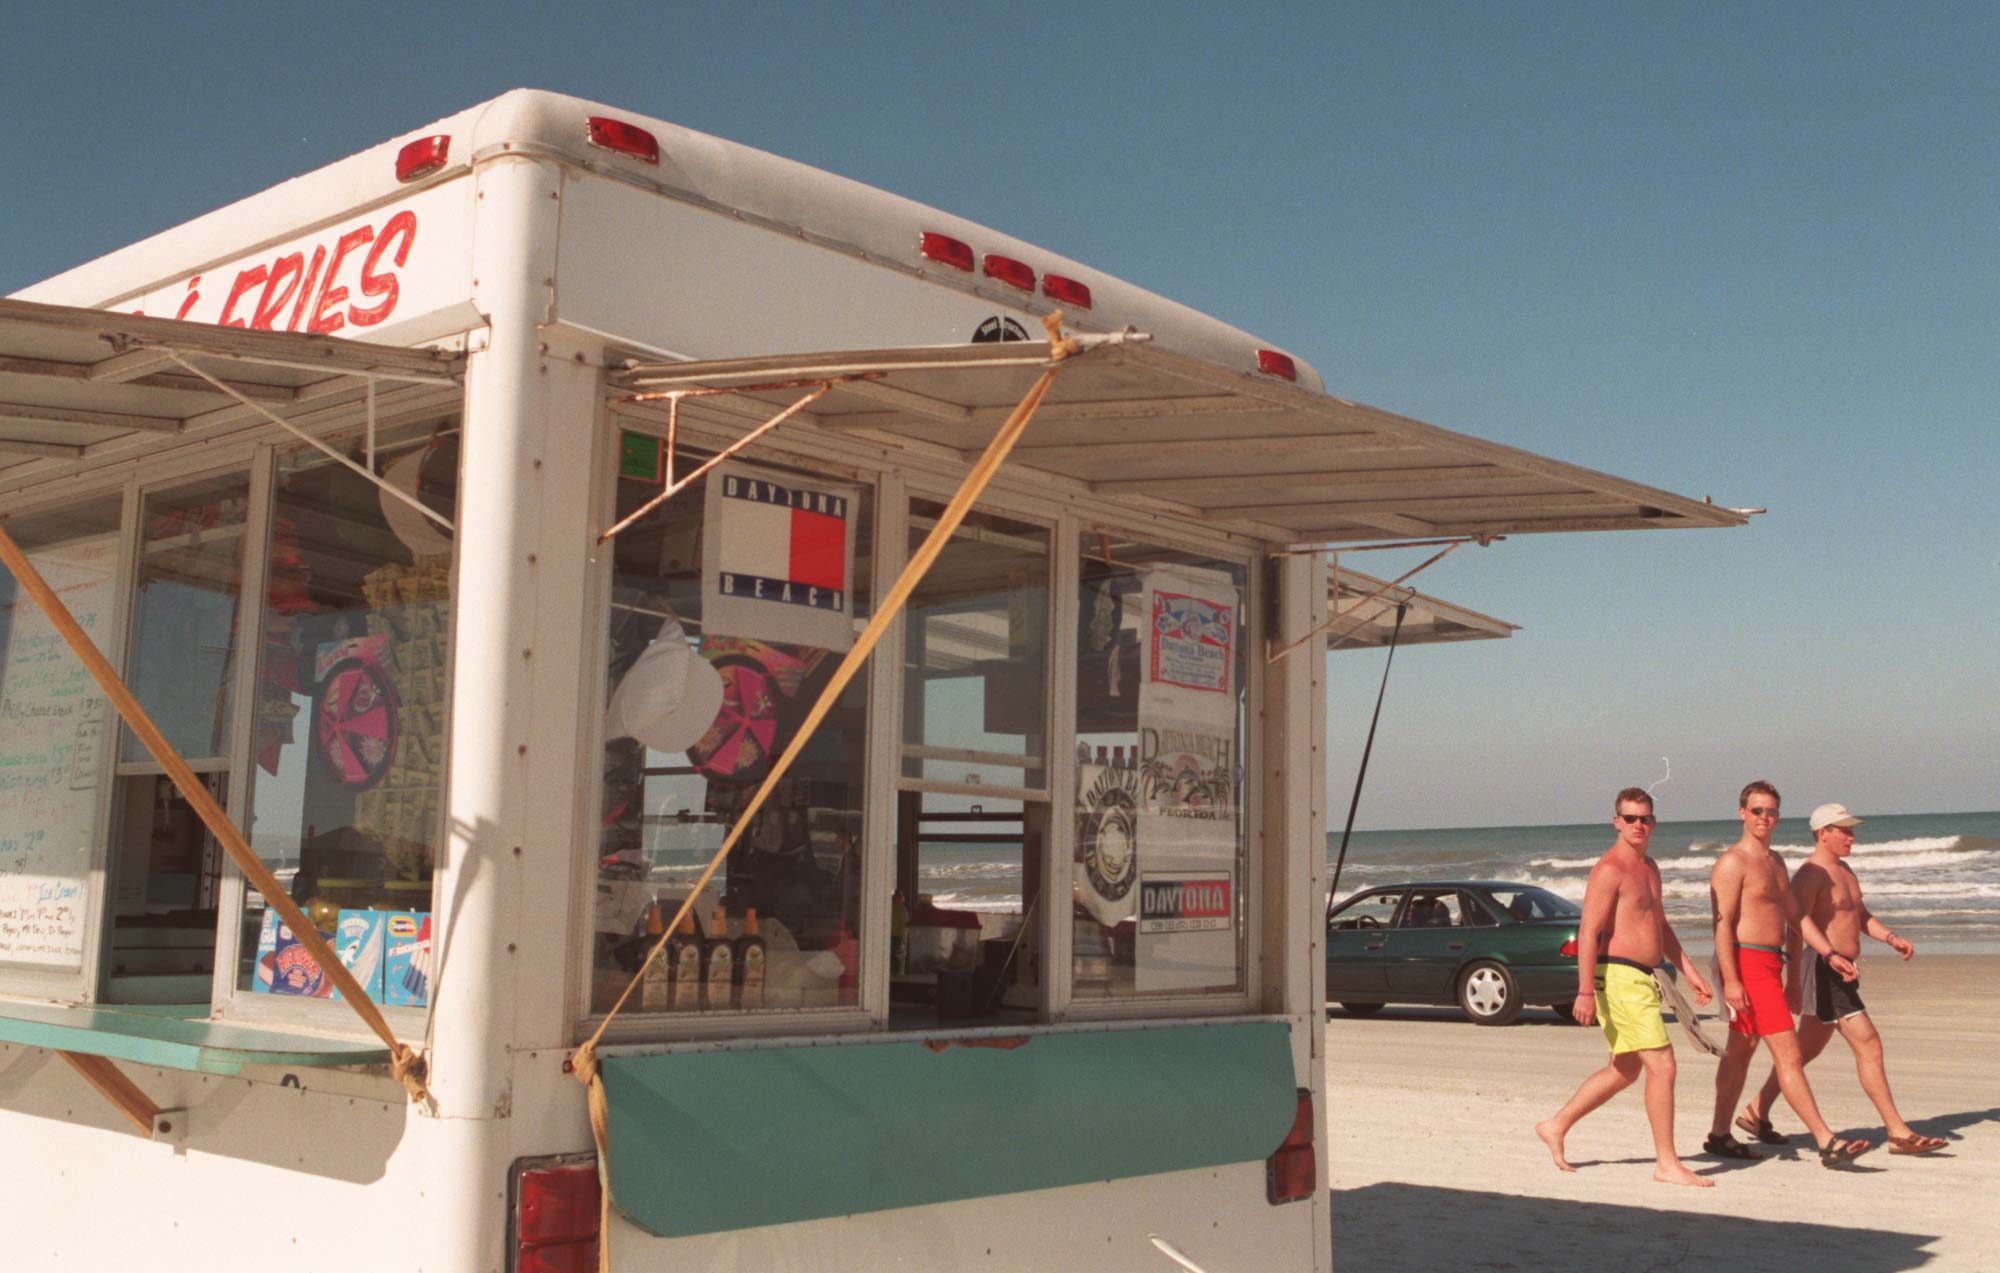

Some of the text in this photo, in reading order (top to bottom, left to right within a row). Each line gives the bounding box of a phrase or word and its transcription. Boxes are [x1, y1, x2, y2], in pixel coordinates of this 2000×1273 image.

[216, 210, 417, 334] FRIES
[724, 574, 840, 610] BEACH
[1159, 808, 1217, 821] FLORIDA
[1144, 886, 1224, 914] DAYTONA
